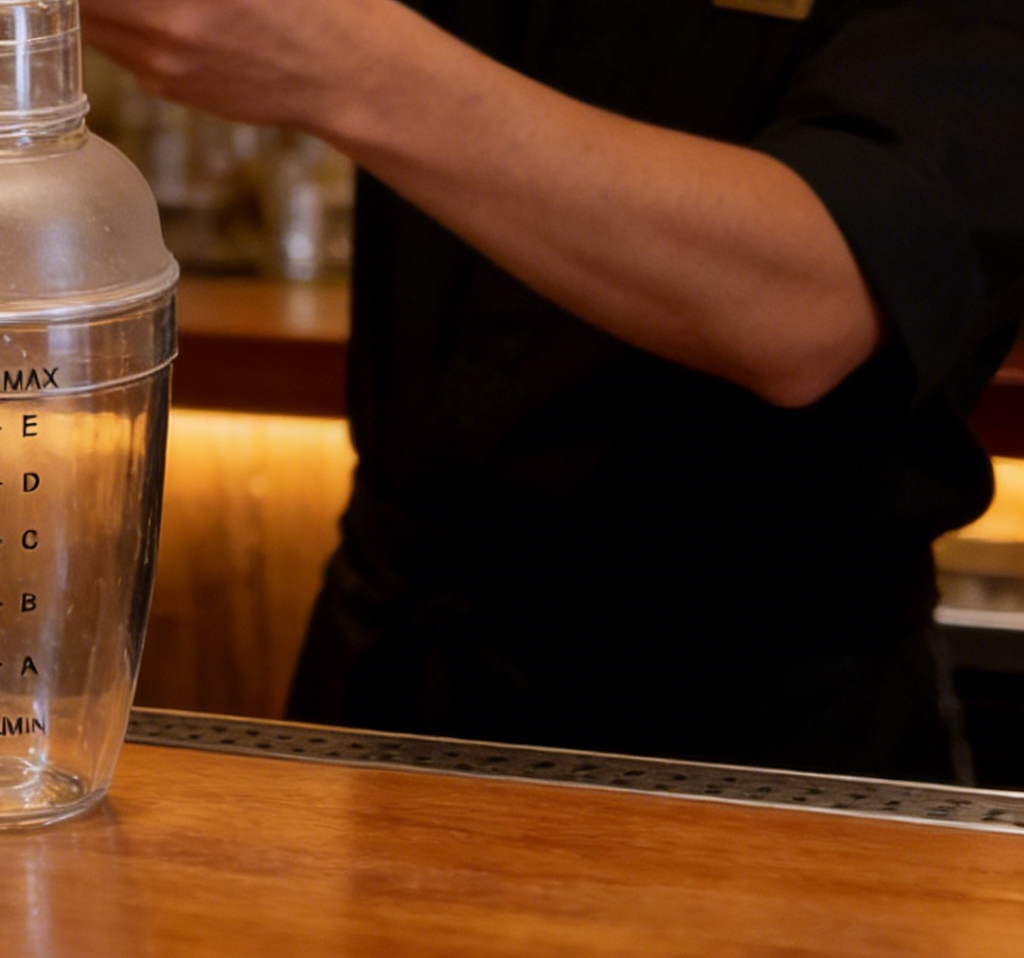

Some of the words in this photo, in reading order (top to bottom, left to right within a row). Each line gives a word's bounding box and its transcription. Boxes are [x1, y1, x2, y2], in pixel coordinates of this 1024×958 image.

[3, 367, 59, 390] MAX
[23, 414, 38, 437] E
[23, 472, 40, 493] D
[21, 529, 38, 550] C
[21, 593, 37, 613] B
[21, 656, 38, 676] A
[2, 717, 47, 736] MIN
